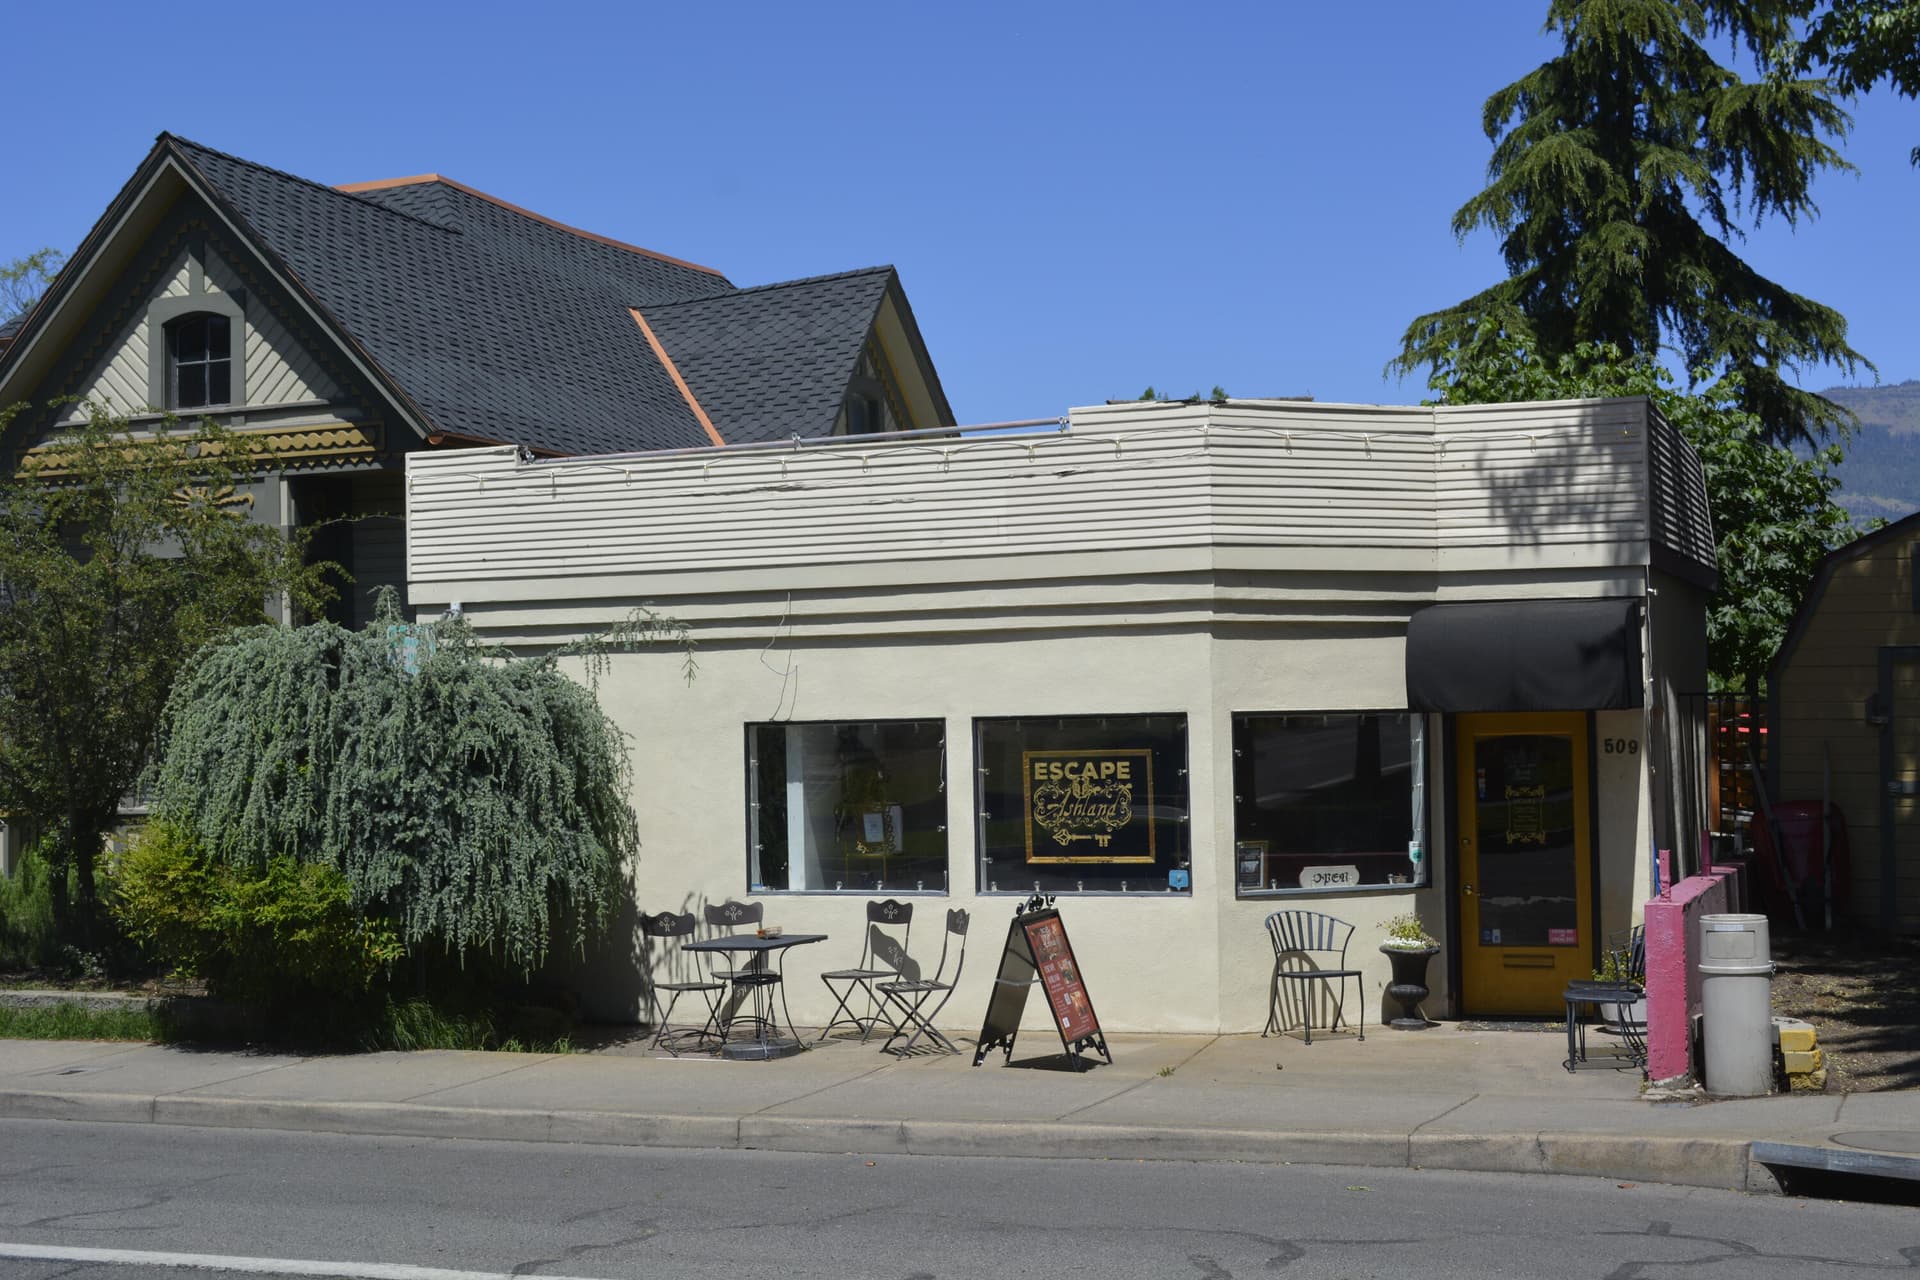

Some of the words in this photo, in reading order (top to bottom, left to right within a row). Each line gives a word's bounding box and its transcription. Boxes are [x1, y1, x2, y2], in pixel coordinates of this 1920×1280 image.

[1604, 737, 1638, 755] 509
[1034, 761, 1131, 780] ESCAPE
[1046, 787, 1120, 817] Ashland
